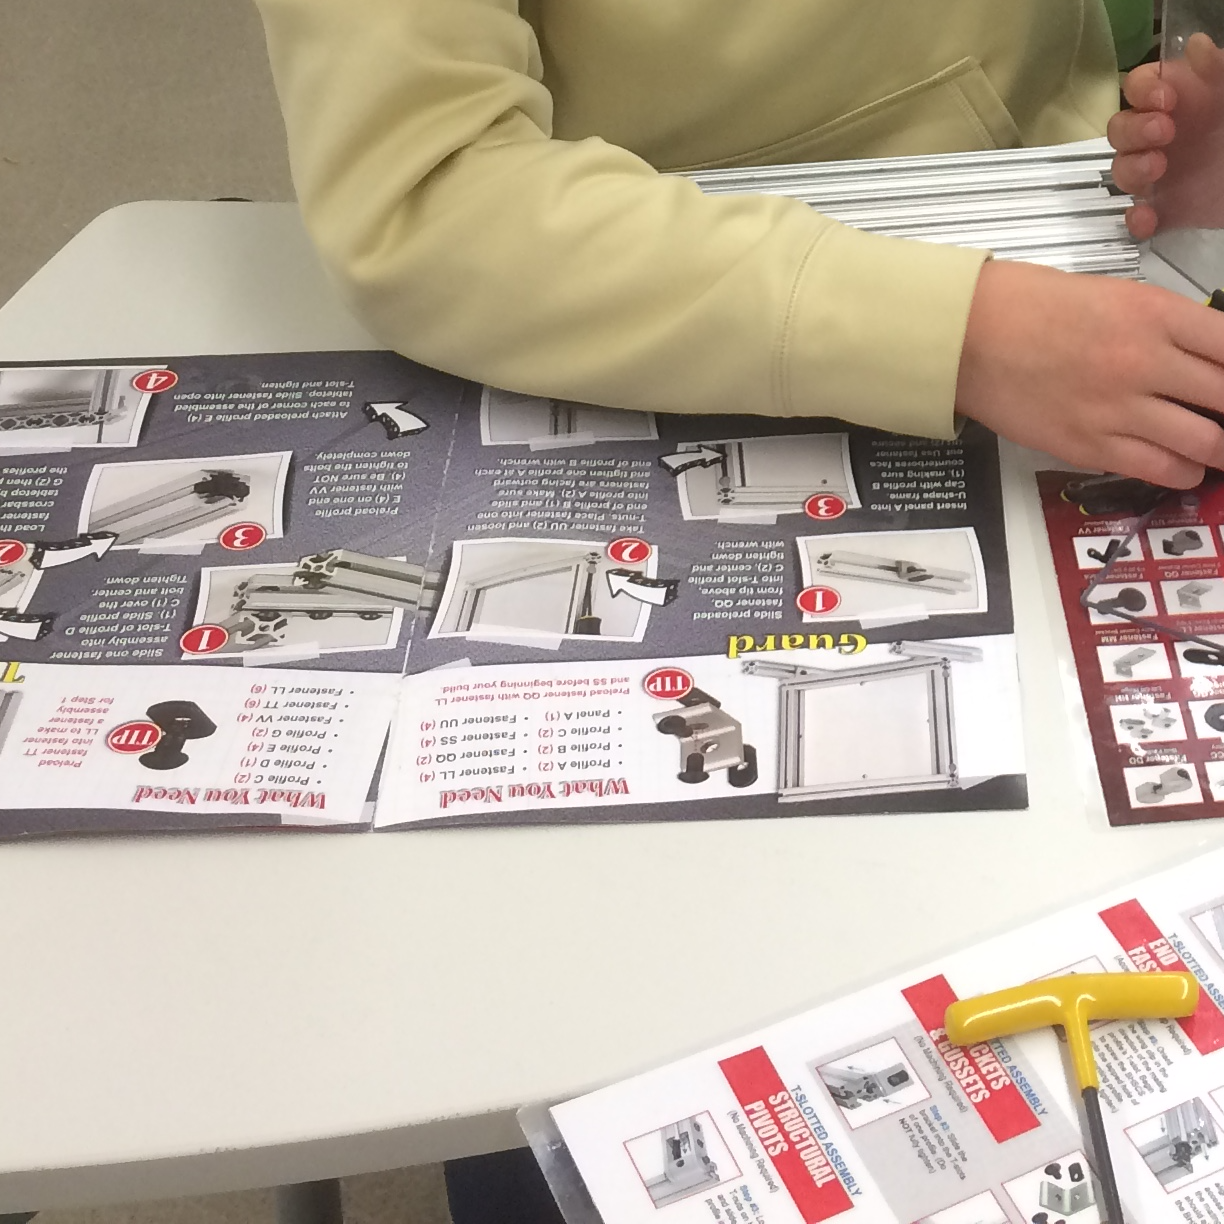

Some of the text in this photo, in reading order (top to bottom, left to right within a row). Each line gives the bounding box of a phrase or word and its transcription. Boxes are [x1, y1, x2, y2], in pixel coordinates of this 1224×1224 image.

[711, 598, 783, 609] fastener QQ,
[692, 608, 783, 621] Slide preloaded
[1100, 632, 1159, 644] Fastener MM
[726, 633, 868, 660] Guard
[48, 648, 164, 660] Slide one fastener
[472, 680, 497, 690] your
[499, 678, 553, 689] beginning
[555, 678, 590, 687] before
[592, 677, 607, 686] SS
[610, 676, 629, 685] and
[650, 675, 688, 692] TIP
[250, 683, 344, 697] Fastener LL (6)
[434, 687, 630, 706] Preload fastener QQ with fastener LL
[69, 695, 97, 705] Step
[97, 697, 115, 705] for
[244, 697, 338, 710] Fastener TT (6)
[55, 704, 110, 715] assembly
[544, 709, 610, 722] Panel A (1)
[47, 716, 95, 726] fastener
[236, 712, 333, 725] Fastener VV (4)
[419, 714, 517, 732] Fastener UU (4)
[36, 726, 99, 736] LL to make
[251, 726, 327, 740] Profile G (2)
[537, 725, 611, 738] Profile C (2)
[21, 736, 94, 746] into fastener
[113, 728, 155, 750] TIP
[420, 731, 516, 749] Fastener SS (4)
[22, 747, 88, 757] fastener TT
[246, 741, 322, 755] Profile E (4)
[537, 741, 611, 755] Profile B (2)
[37, 759, 83, 768] Preload
[239, 756, 316, 770] Profile D (1)
[415, 747, 516, 766] Fastener QQ (2)
[537, 758, 611, 772] Profile A (2)
[233, 772, 310, 786] Profile C (2)
[419, 764, 515, 783] Fastener LL (4)
[131, 784, 326, 810] What You Need
[439, 777, 630, 809] What You Need
[1147, 937, 1179, 967] END
[1167, 932, 1209, 982] T-SLOTTED
[921, 1047, 948, 1081] Machining
[943, 1079, 968, 1113] Required)
[1005, 1064, 1049, 1116] ASSEMBLY
[744, 1099, 788, 1157] PIVOTS
[767, 1089, 835, 1188] STRUCTURAL
[790, 1084, 863, 1196] T-SLOTTED ASSEMBLY
[726, 1111, 780, 1194] (No Machining Required)
